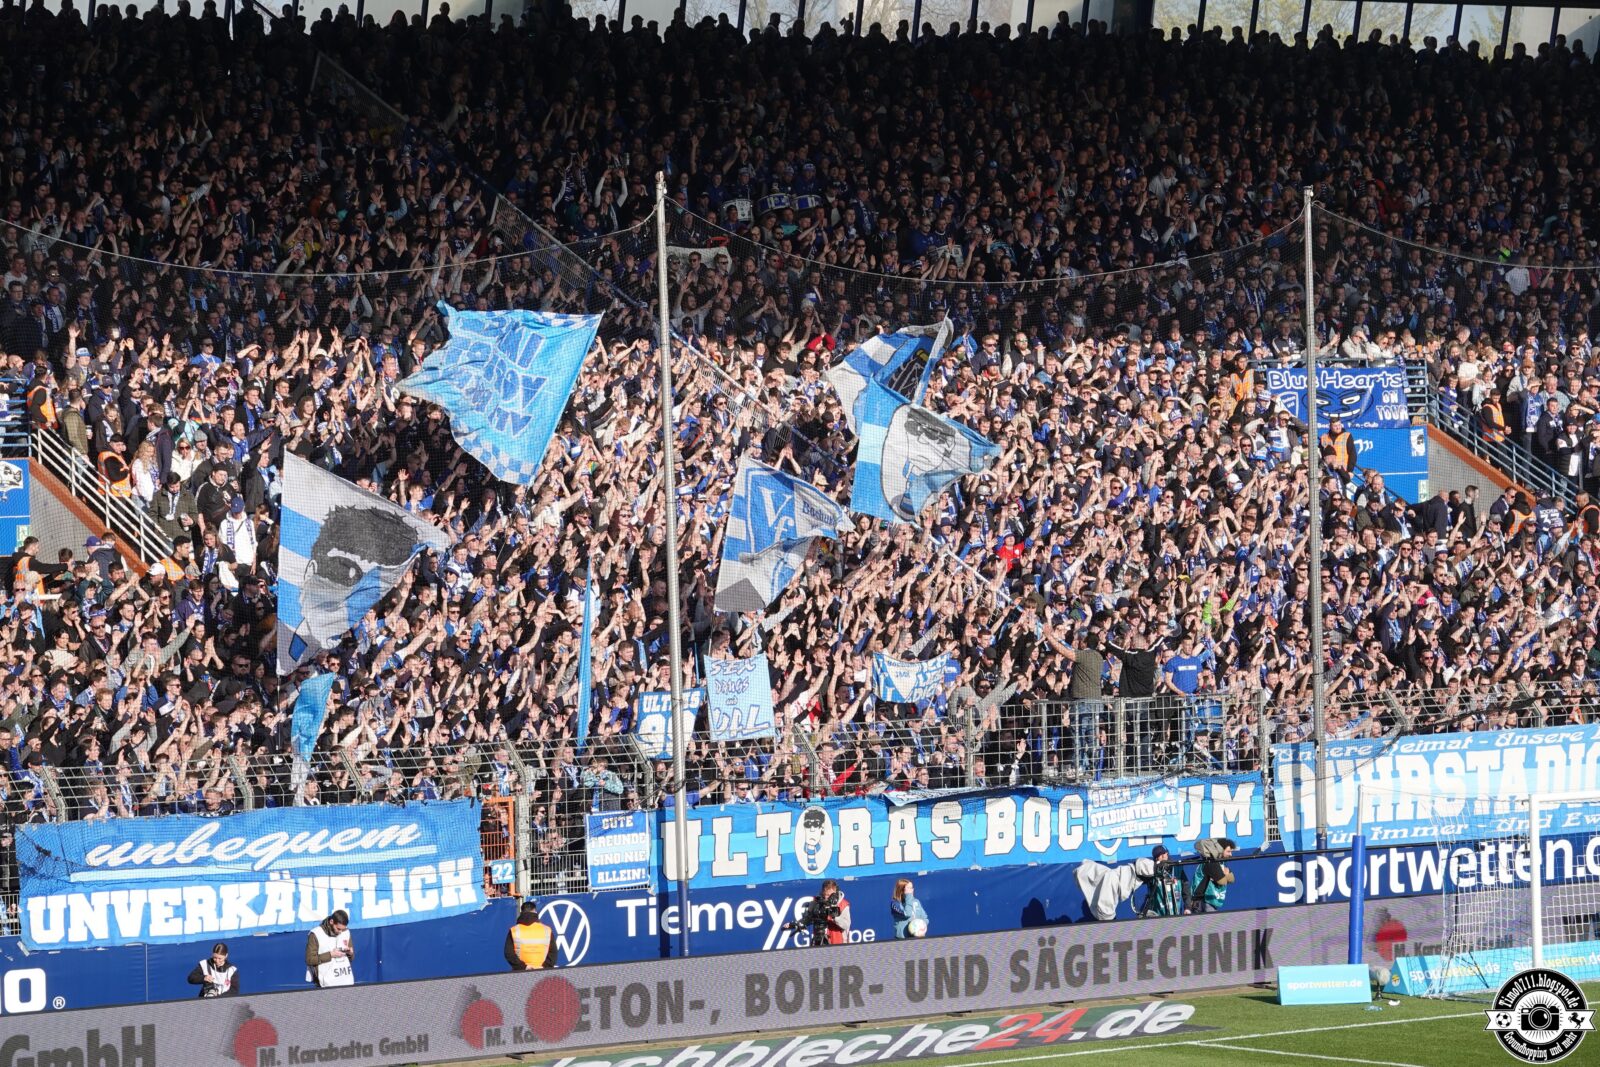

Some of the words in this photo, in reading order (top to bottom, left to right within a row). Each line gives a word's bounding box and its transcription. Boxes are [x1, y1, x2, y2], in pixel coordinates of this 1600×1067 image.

[1321, 370, 1404, 388] Hearts
[1382, 389, 1399, 404] ON
[710, 659, 757, 676] SEX
[714, 676, 749, 695] DRUGS
[1273, 743, 1374, 762] Unere
[1494, 731, 1585, 748] Unsere
[601, 814, 635, 830] GUTE
[984, 781, 1256, 856] BOCUM
[85, 821, 423, 870] unbequem
[591, 831, 647, 849] FREUNDE
[592, 852, 621, 867] SIND
[623, 849, 647, 863] NIE
[492, 862, 514, 881] 22
[597, 867, 647, 884] ALLEIN!
[27, 857, 478, 944] UNVERKÄUFLICH
[616, 895, 815, 950] Tiemey
[745, 964, 885, 1018] BOHR-
[905, 954, 989, 1002] UND
[1009, 927, 1275, 994] SÄGETECHNIK
[1286, 979, 1363, 991] sportwetten.de
[485, 1027, 506, 1048] M.
[259, 1047, 282, 1067] M.
[378, 1033, 429, 1056] GmbH
